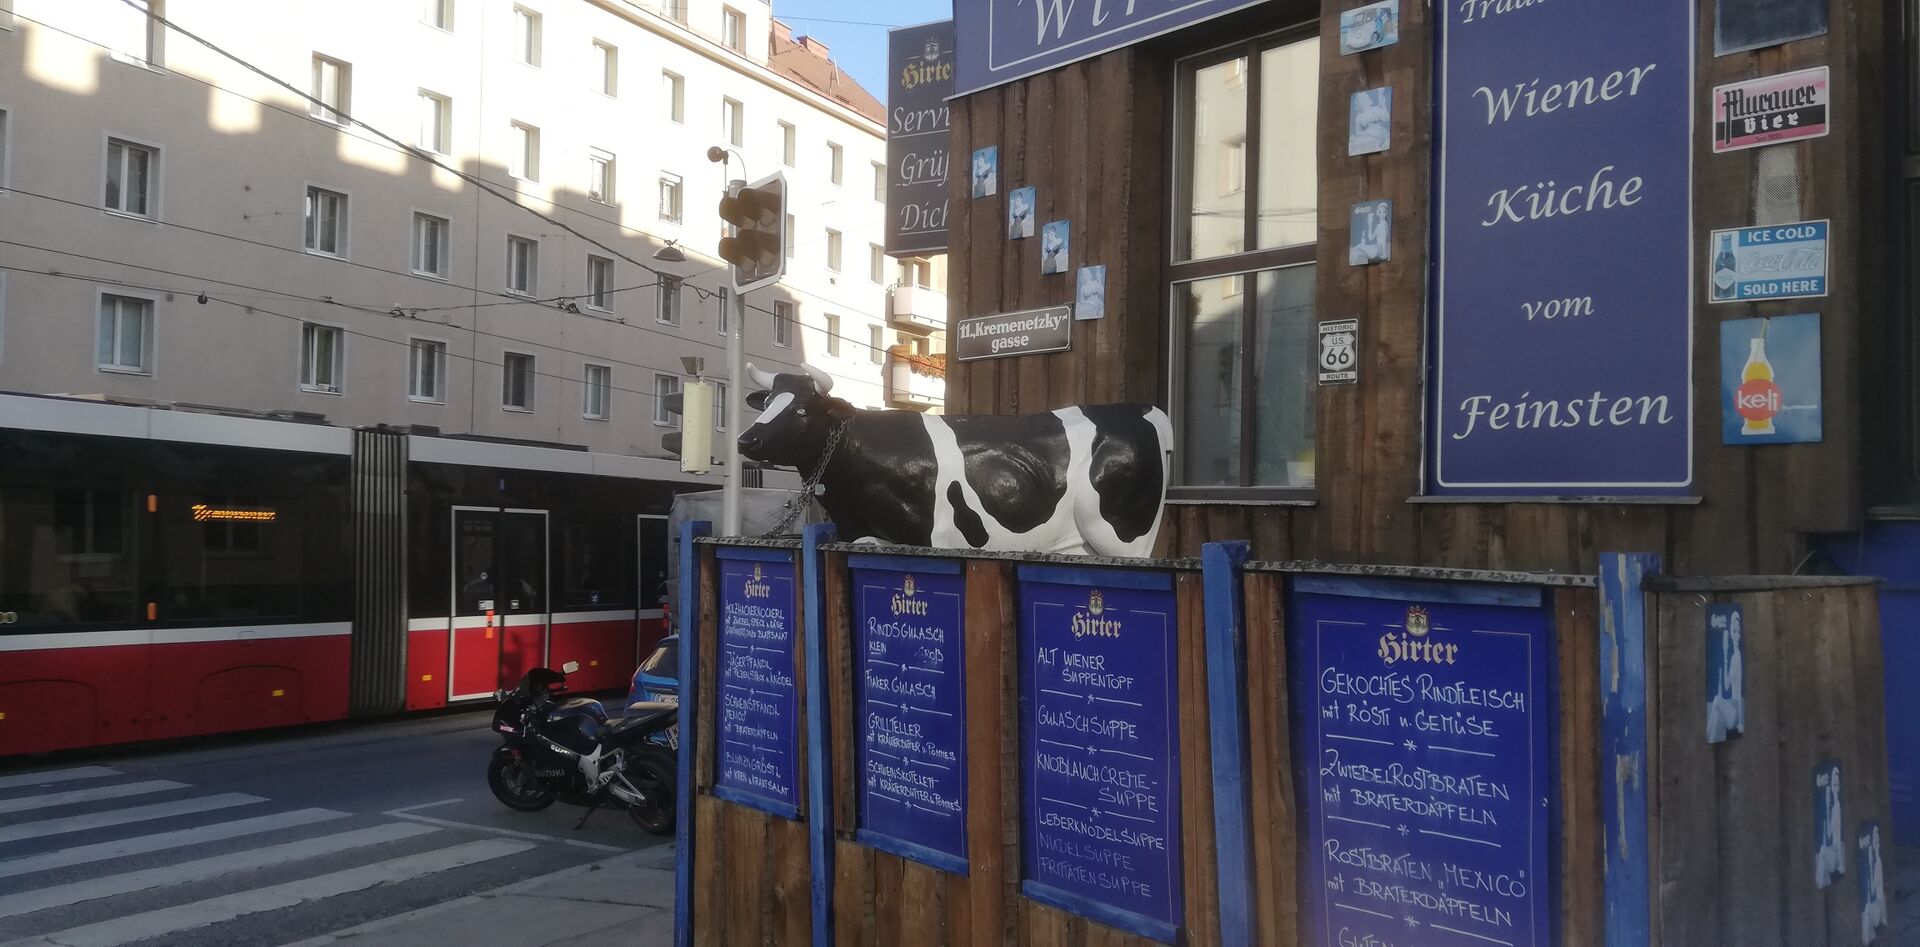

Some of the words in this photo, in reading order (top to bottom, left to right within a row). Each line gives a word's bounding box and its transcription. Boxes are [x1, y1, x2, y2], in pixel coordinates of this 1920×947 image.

[901, 60, 951, 91] Hirte
[1472, 63, 1656, 125] Wiener
[891, 106, 950, 134] Serv
[1722, 84, 1816, 145] Murauer
[1744, 112, 1799, 134] Bier
[1481, 165, 1643, 226] Küche
[1748, 230, 1771, 242] ICE
[1775, 226, 1816, 240] COLD
[1743, 283, 1778, 295] SOLD
[1782, 280, 1818, 293] HERE
[1521, 296, 1595, 321] vom
[1322, 324, 1354, 332] HISTORIC
[991, 335, 1030, 353] gasse
[1326, 347, 1349, 365] 66
[1738, 389, 1778, 411] keli
[1452, 391, 1674, 440] Feinsten
[744, 579, 771, 598] Hirter
[891, 594, 928, 617] Hirter
[1071, 612, 1121, 640] Hirter
[1038, 647, 1058, 666] ALT
[1063, 650, 1105, 671] WIENER
[1377, 632, 1458, 668] Hirter
[891, 676, 937, 699] GULASCH
[1062, 668, 1134, 690] SUPPENTOPF
[1321, 667, 1414, 703] GEKOCHTES
[1416, 674, 1525, 713] RINDFLEISCH
[868, 712, 924, 738] GRILLTELLER
[1322, 700, 1339, 720] mit
[1347, 700, 1391, 727] RÖSTI
[1415, 708, 1499, 737] GEMÜSE
[1098, 787, 1159, 812] SUPPE
[1324, 784, 1341, 802] mit
[1351, 788, 1497, 826] BRATERDÄPFELN
[1040, 832, 1135, 871] NUDELSUPPE
[1325, 838, 1433, 882] ROSTBRATEN
[1327, 873, 1344, 892] mit
[1353, 877, 1512, 927] BRATERDÄPFELN
